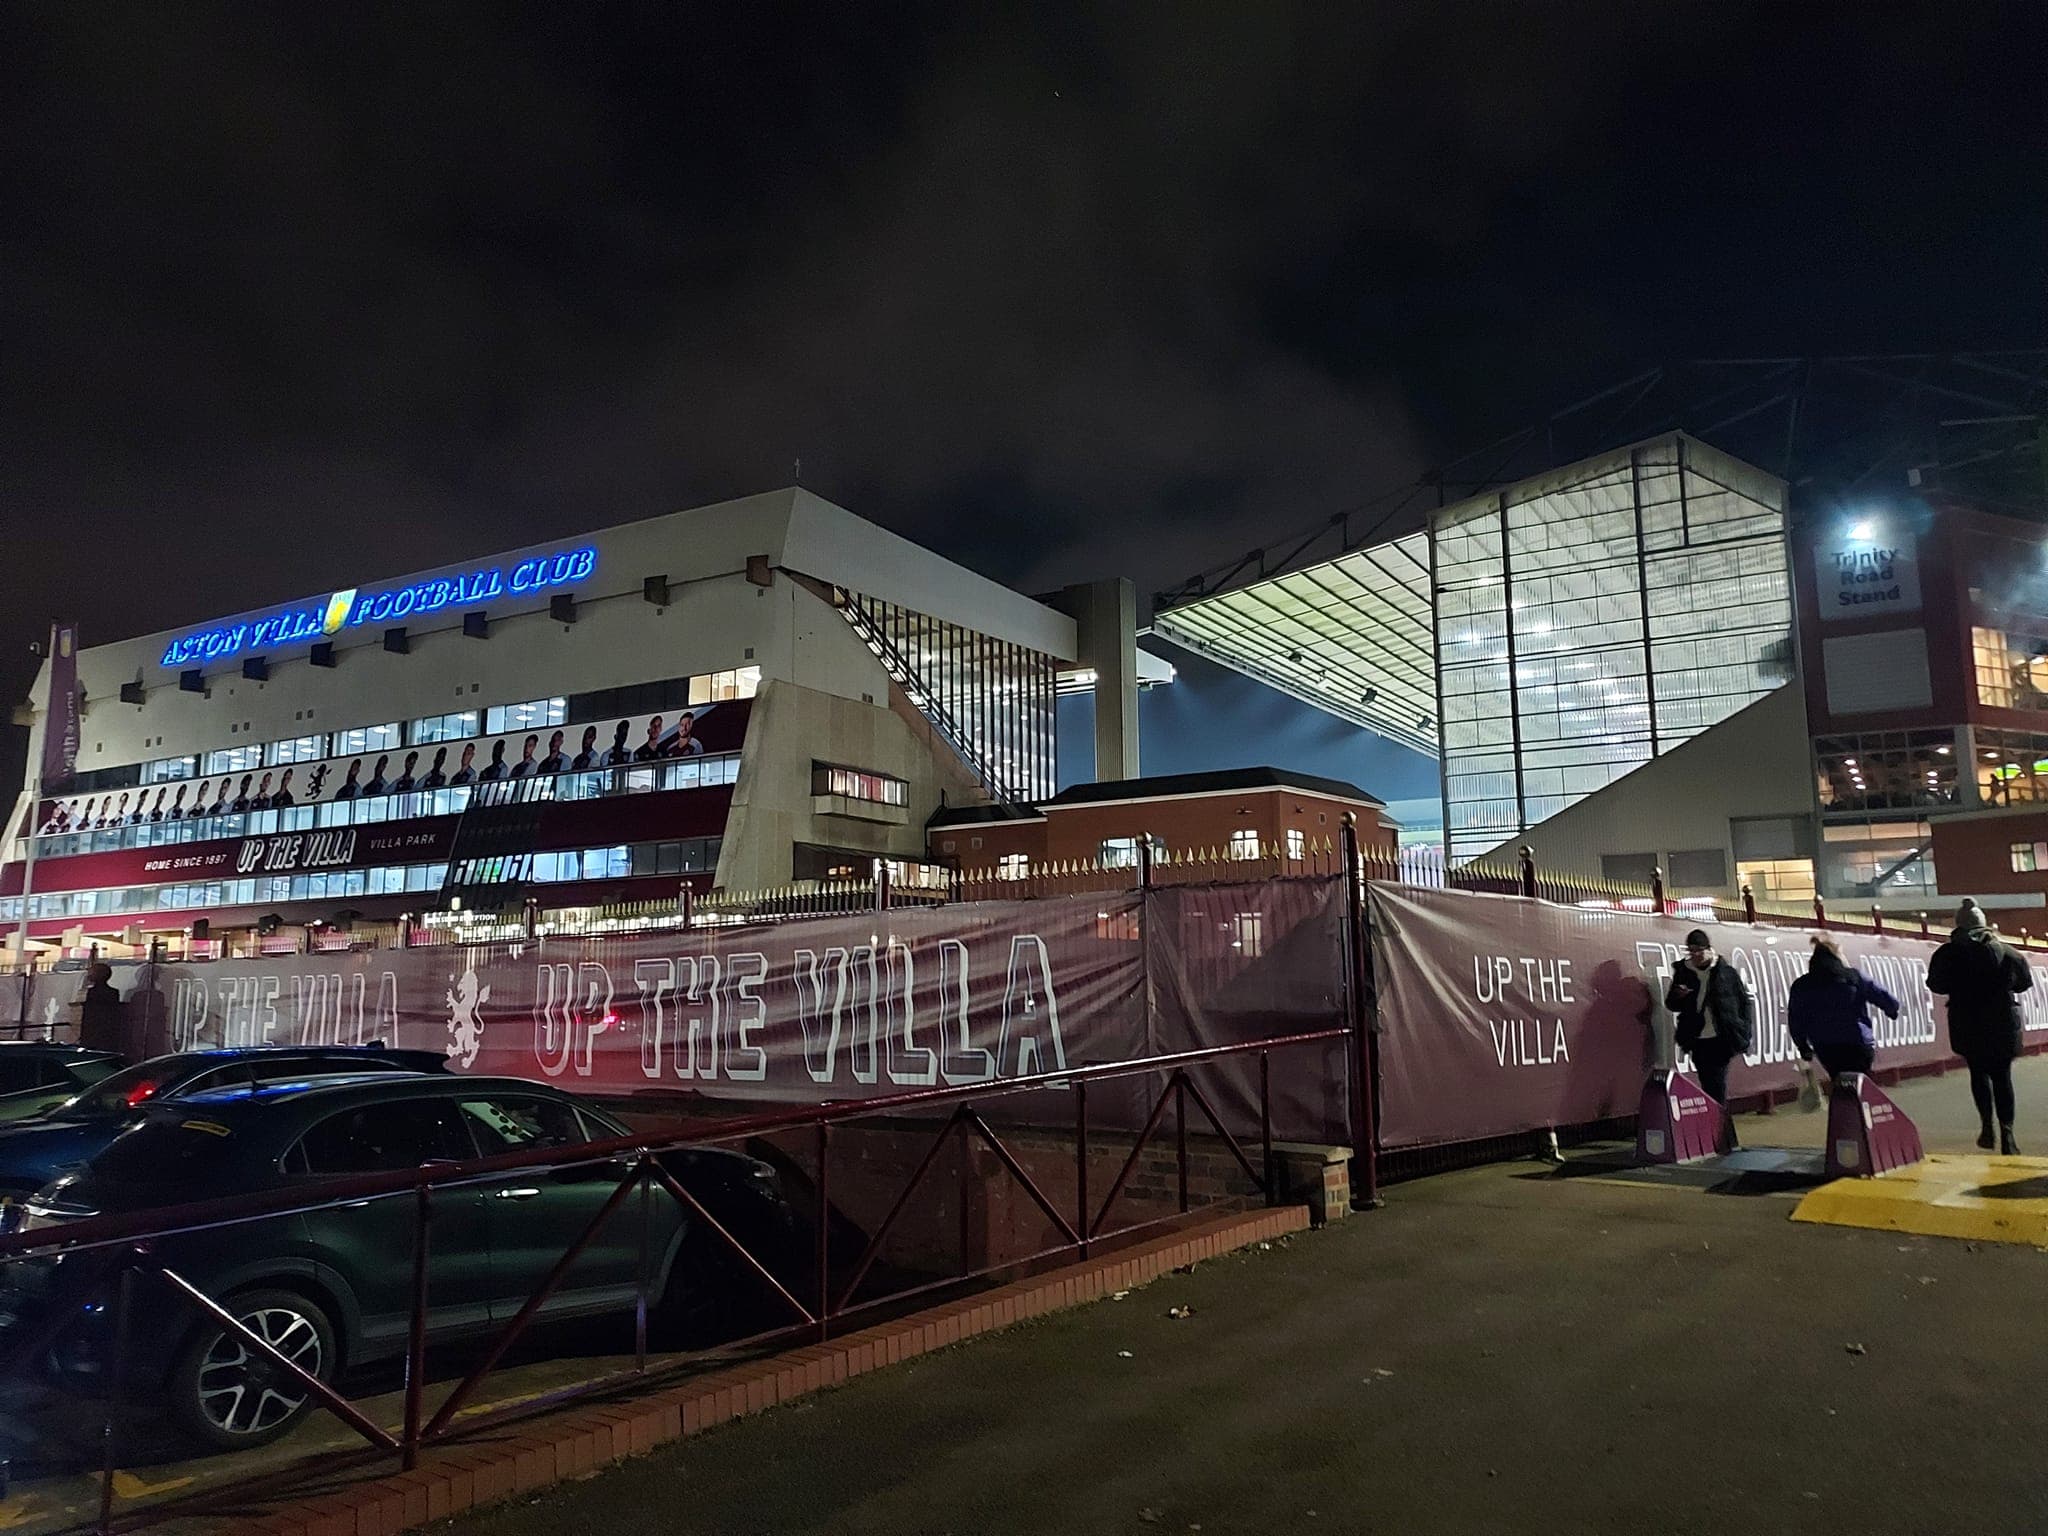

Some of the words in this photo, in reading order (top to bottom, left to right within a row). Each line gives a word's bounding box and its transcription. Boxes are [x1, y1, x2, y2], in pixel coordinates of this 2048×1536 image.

[1831, 547, 1898, 566] Trinity
[1841, 566, 1894, 585] Road
[161, 625, 248, 665] ASTON
[252, 608, 324, 647] VILLA
[351, 571, 503, 624] FOOTBALL
[509, 549, 596, 591] CLUB
[1839, 584, 1901, 606] Stand
[236, 839, 265, 873] UP
[264, 836, 303, 871] THE
[302, 829, 357, 868] VILLA
[370, 836, 401, 849] VILLA
[405, 833, 437, 846] PARK
[144, 859, 171, 871] HOME
[174, 856, 202, 869] SINCE
[1473, 955, 1512, 1003] UP
[1519, 957, 1575, 1002] THE
[171, 978, 209, 1053] UP
[219, 976, 279, 1049] THE
[290, 971, 399, 1049] VILLA
[534, 963, 614, 1077] UP
[634, 952, 769, 1081] THE
[794, 934, 1070, 1090] VILLA
[1489, 1019, 1570, 1067] VILLA
